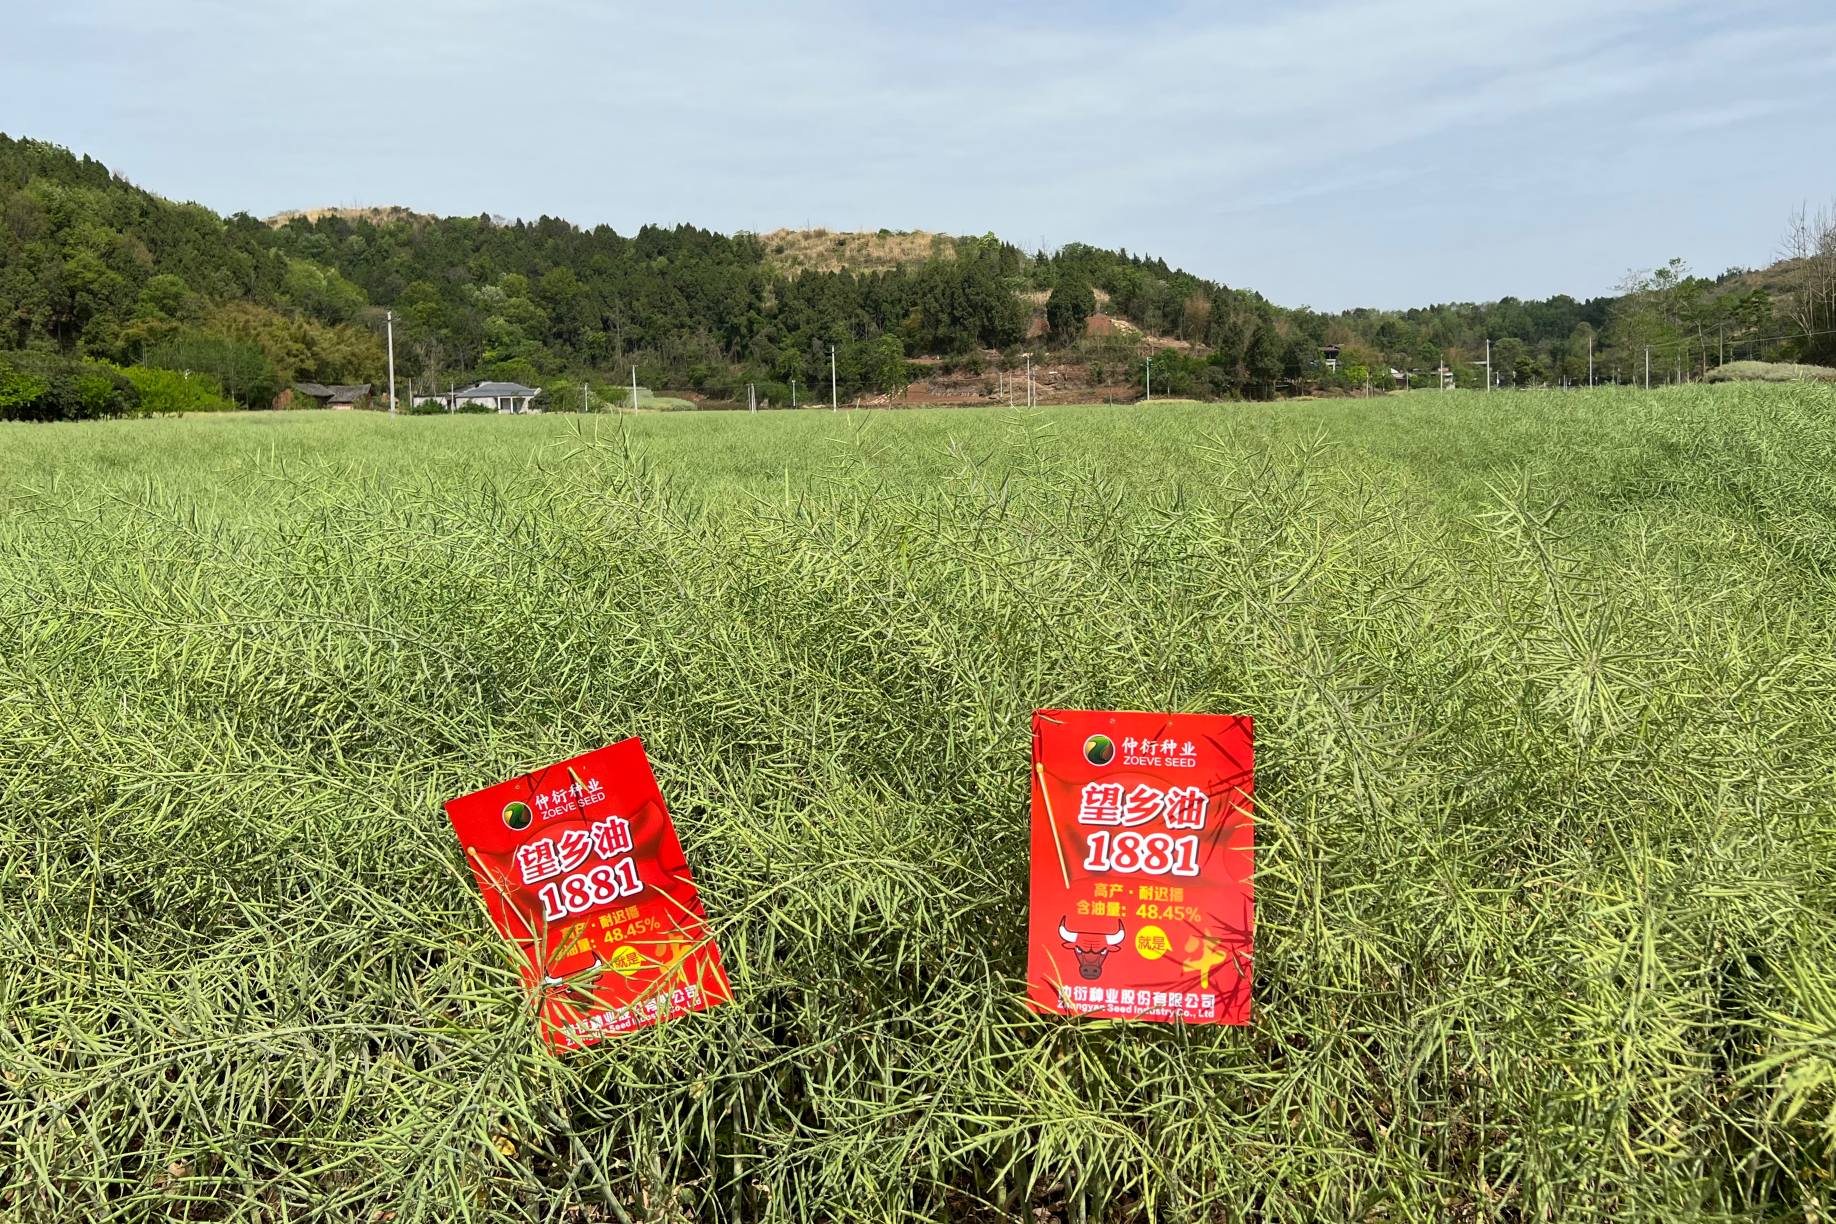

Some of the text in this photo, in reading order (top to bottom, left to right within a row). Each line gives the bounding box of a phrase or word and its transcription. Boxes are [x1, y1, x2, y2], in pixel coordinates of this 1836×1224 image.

[1121, 737, 1197, 756] 仲衍种业
[1123, 756, 1196, 768] ZOEVE SEED
[535, 778, 603, 810] 仲衍种业
[541, 792, 606, 820] ZOEVE SEED
[1078, 782, 1209, 829] 望乡油
[517, 816, 633, 884] 望乡油
[1084, 830, 1200, 876] 1881
[538, 857, 643, 921] 1881
[1136, 904, 1202, 922] 48.45%
[604, 916, 661, 943] 48.45%
[1138, 936, 1166, 951] 就是
[1107, 1003, 1132, 1013] Seed
[1198, 1009, 1215, 1018] Ltd
